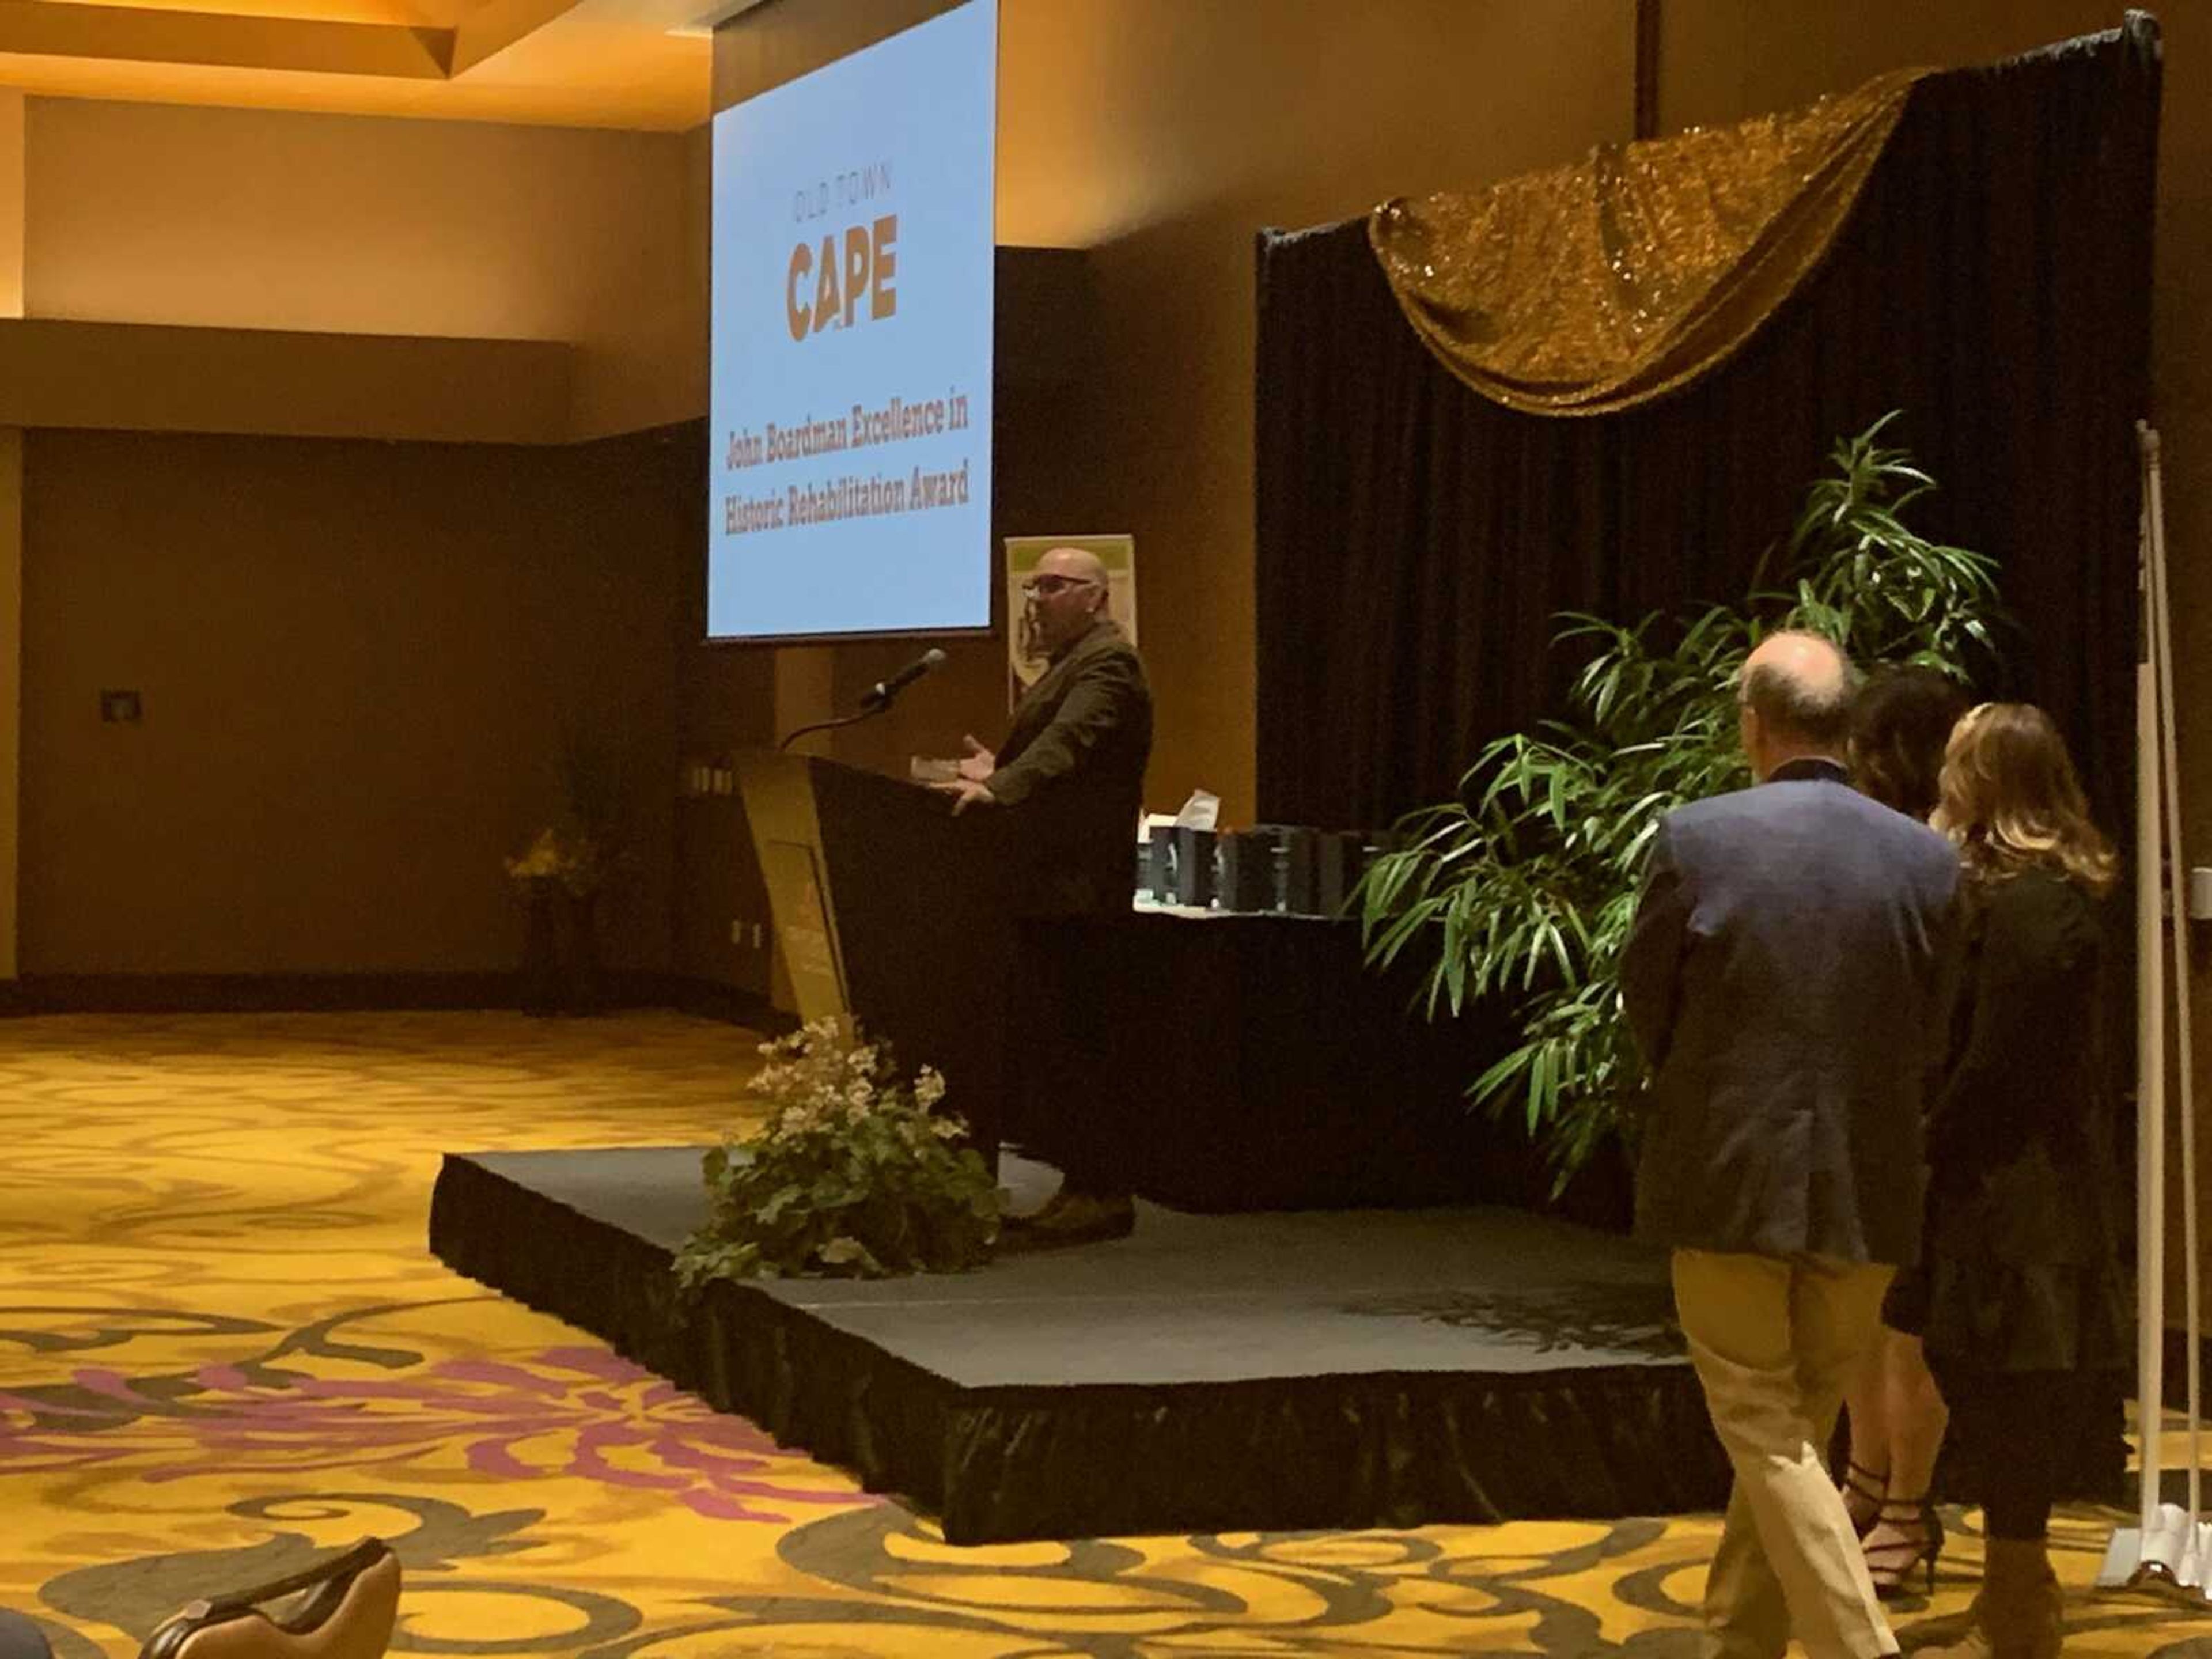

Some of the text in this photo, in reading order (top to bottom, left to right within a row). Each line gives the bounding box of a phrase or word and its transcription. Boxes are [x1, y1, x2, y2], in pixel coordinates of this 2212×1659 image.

[787, 214, 897, 342] CAPE
[727, 386, 969, 469] John Boardman Excellence in
[725, 459, 969, 535] Historic Rehabilitation Award
